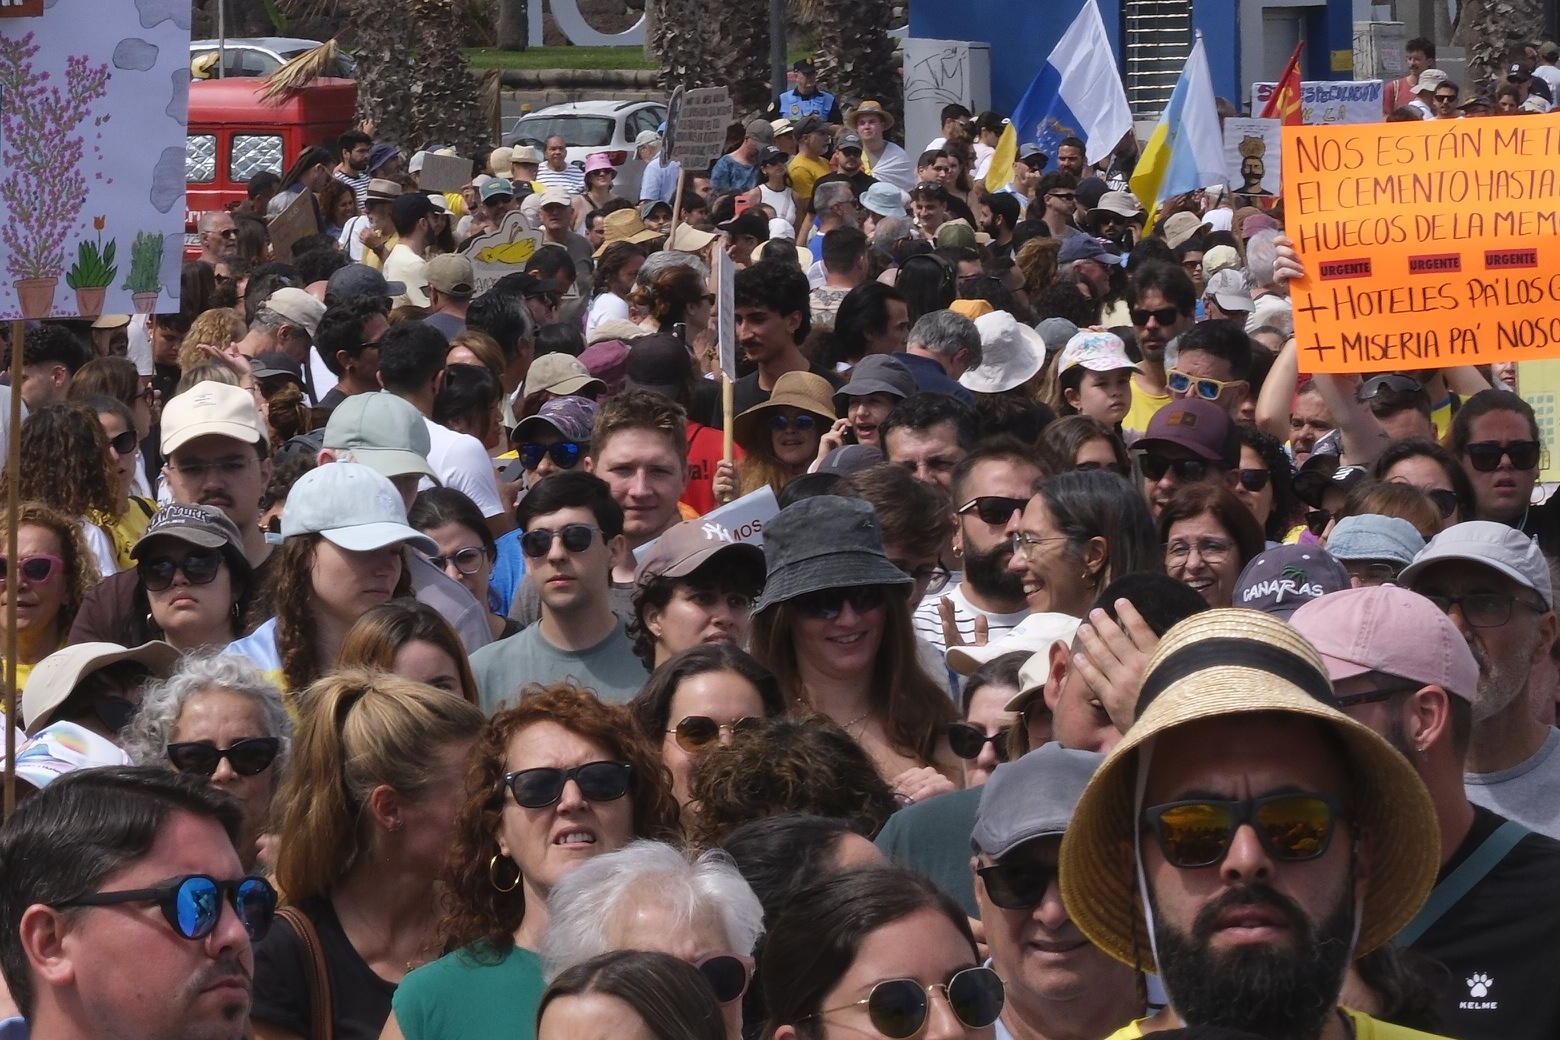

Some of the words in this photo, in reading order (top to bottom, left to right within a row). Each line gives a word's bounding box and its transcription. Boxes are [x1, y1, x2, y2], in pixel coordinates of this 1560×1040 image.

[1296, 135, 1364, 174] NOS
[1377, 125, 1482, 167] ESTÁN
[1494, 127, 1560, 156] MET
[1297, 180, 1336, 215] EL
[1338, 170, 1469, 209] CEMENTO
[1474, 168, 1555, 202] HASTA
[1299, 214, 1408, 254] HUECOS
[1415, 213, 1448, 242] DE
[1453, 212, 1484, 240] LA
[1320, 262, 1370, 277] URGENTE
[1409, 257, 1460, 271] URGENTE
[1485, 252, 1537, 266] URGENTE
[1333, 283, 1459, 321] HOTELES
[1504, 276, 1544, 306] LOS
[1341, 329, 1440, 363] MISERIA
[1459, 1001, 1498, 1010] KELME
